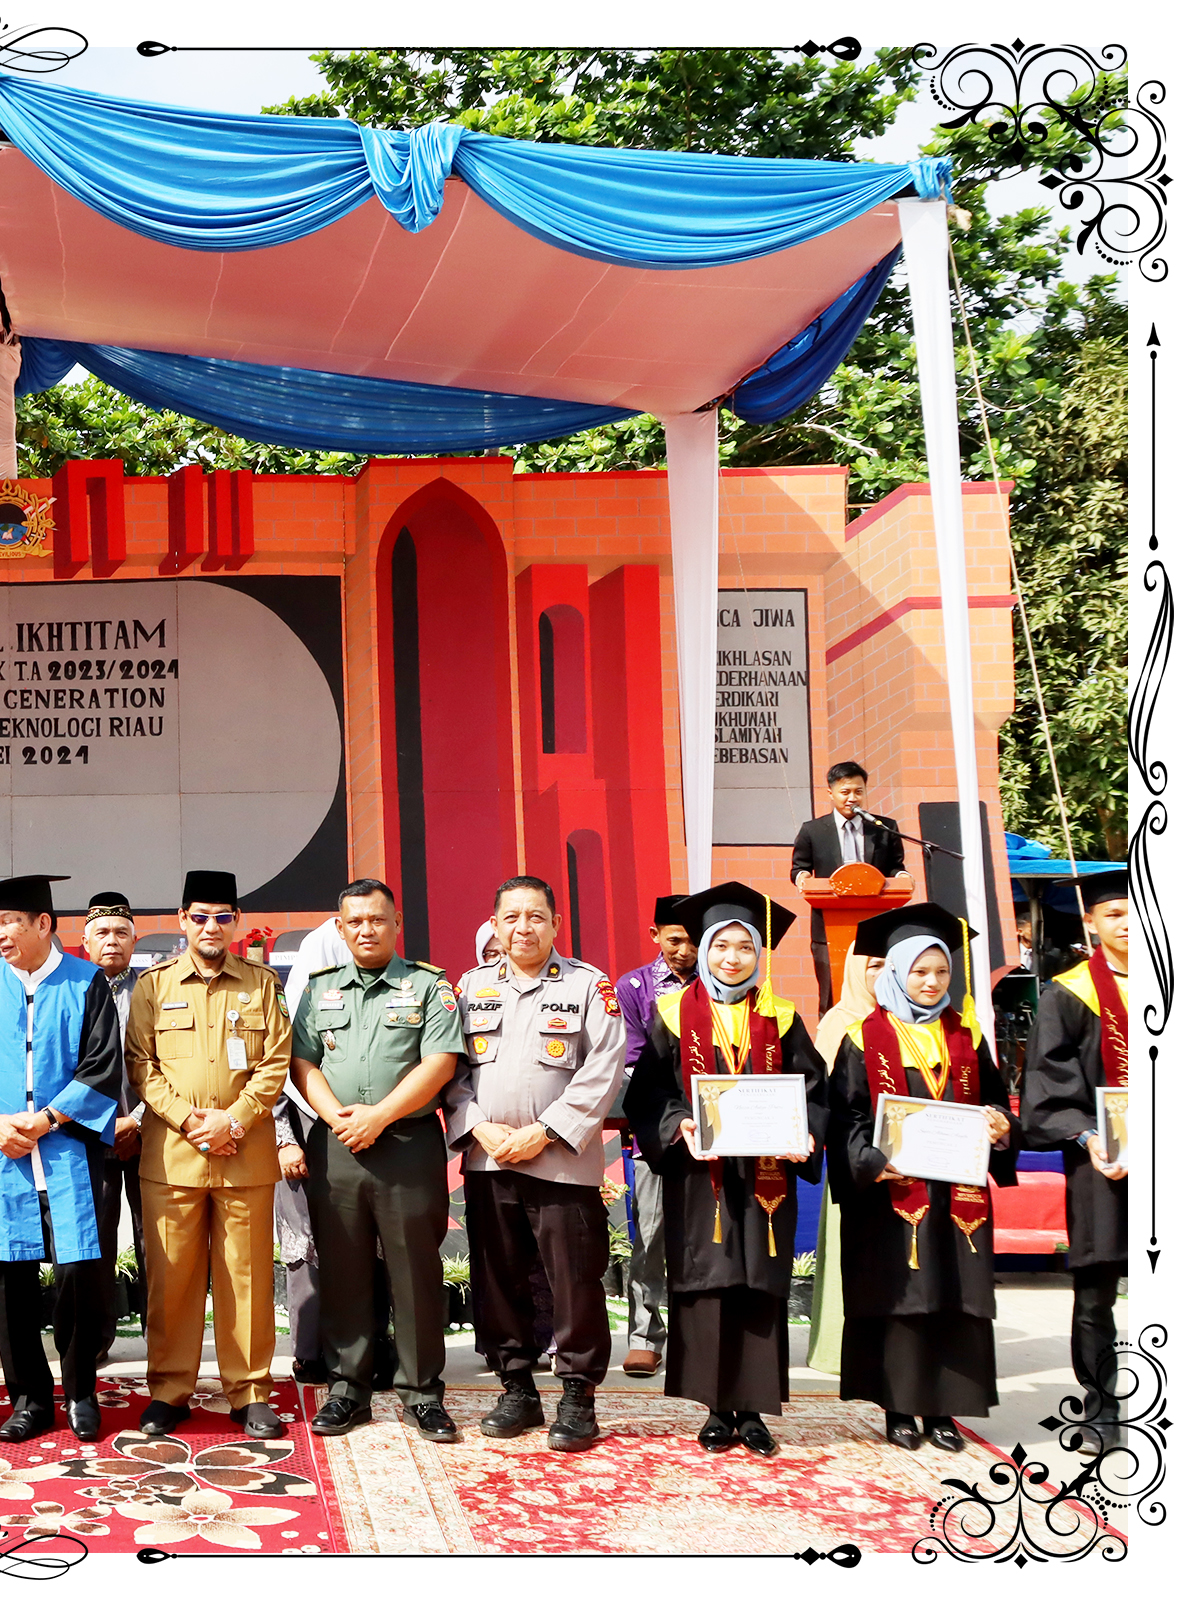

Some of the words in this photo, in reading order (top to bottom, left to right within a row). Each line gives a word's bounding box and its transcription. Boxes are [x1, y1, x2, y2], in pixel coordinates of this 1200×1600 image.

[717, 608, 741, 627] CA
[753, 608, 795, 627] JIWA
[16, 618, 167, 653] IKHTITAM
[717, 650, 792, 667] IKHLASAN
[14, 661, 43, 682] T.A
[47, 659, 179, 681] 2023/2024
[3, 687, 165, 710] GENERATION
[109, 716, 164, 737] RIAU
[22, 745, 89, 765] 2024
[468, 1003, 502, 1012] RAZIF
[541, 1003, 579, 1013] POLRI
[765, 1043, 776, 1071] Nezza
[925, 1113, 965, 1122] SERTIFIKAT
